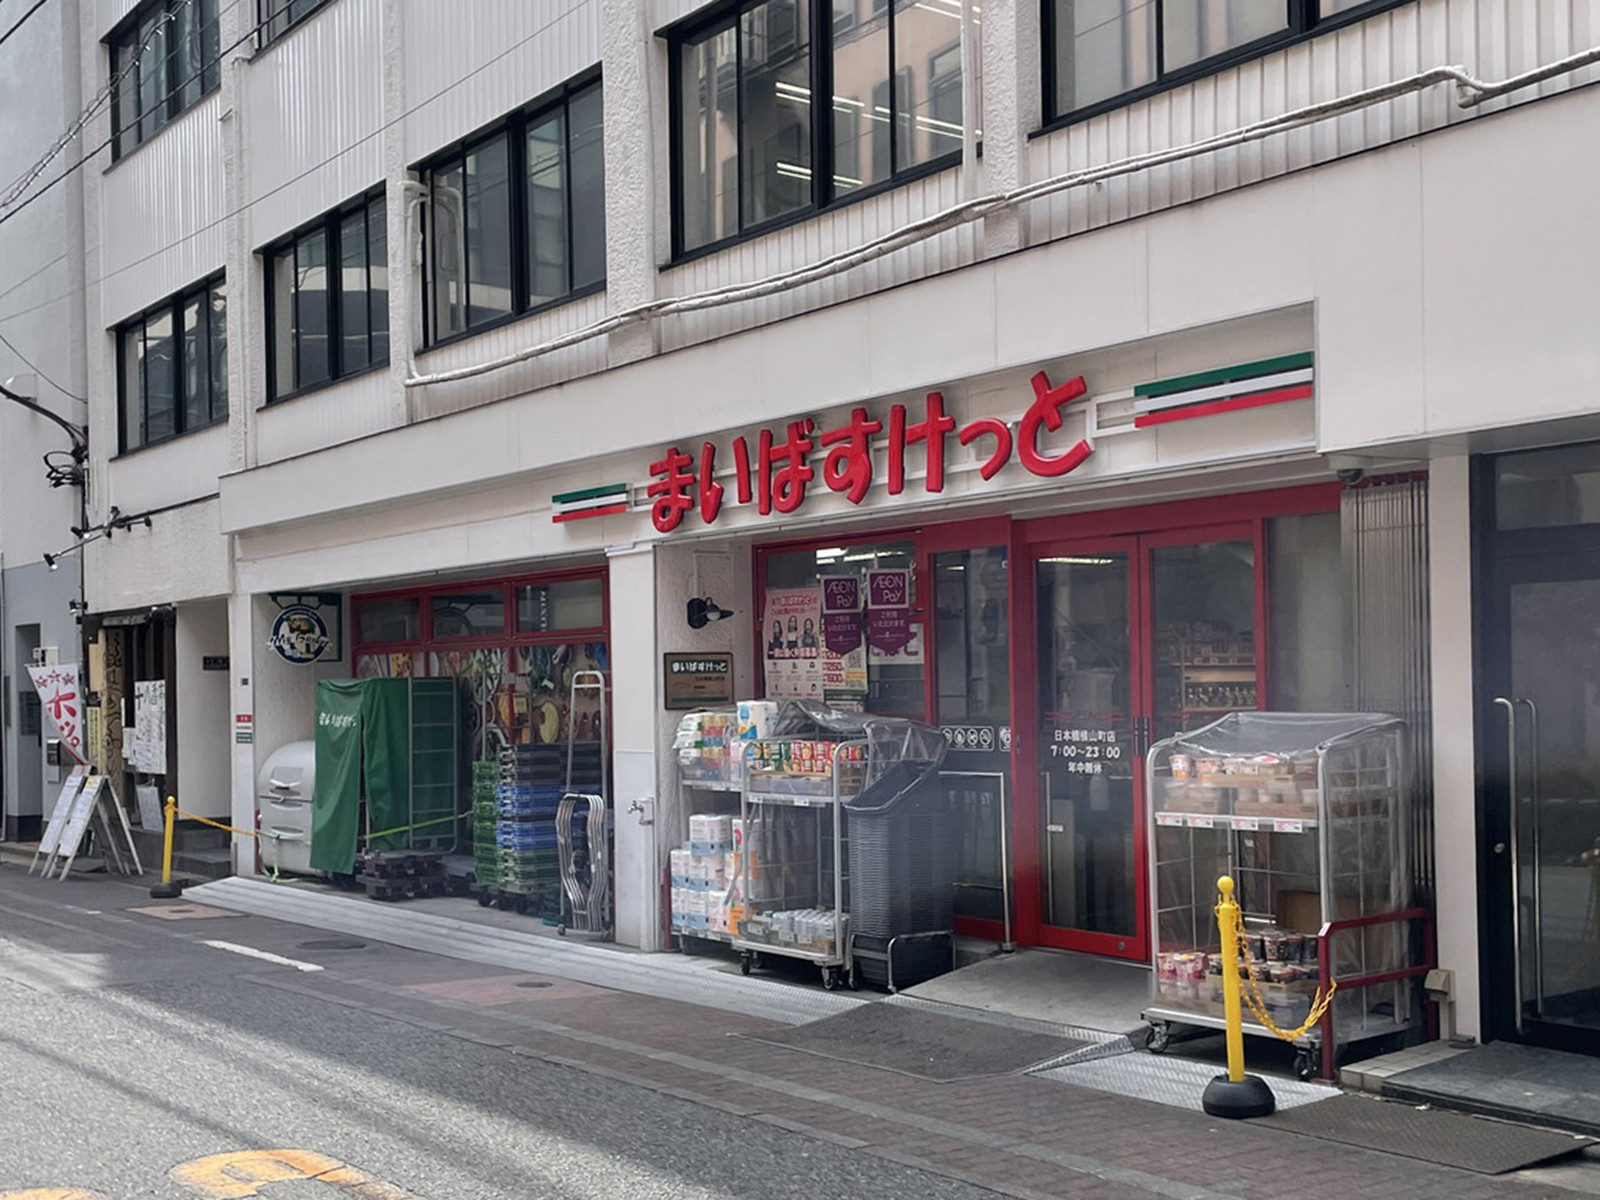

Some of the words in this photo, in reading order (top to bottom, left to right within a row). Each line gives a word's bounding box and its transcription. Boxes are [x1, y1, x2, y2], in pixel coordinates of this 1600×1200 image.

[647, 369, 1092, 533] まいばすけっと
[672, 661, 727, 673] まいばすけっと
[1054, 729, 1116, 742] 日本橋横山町店
